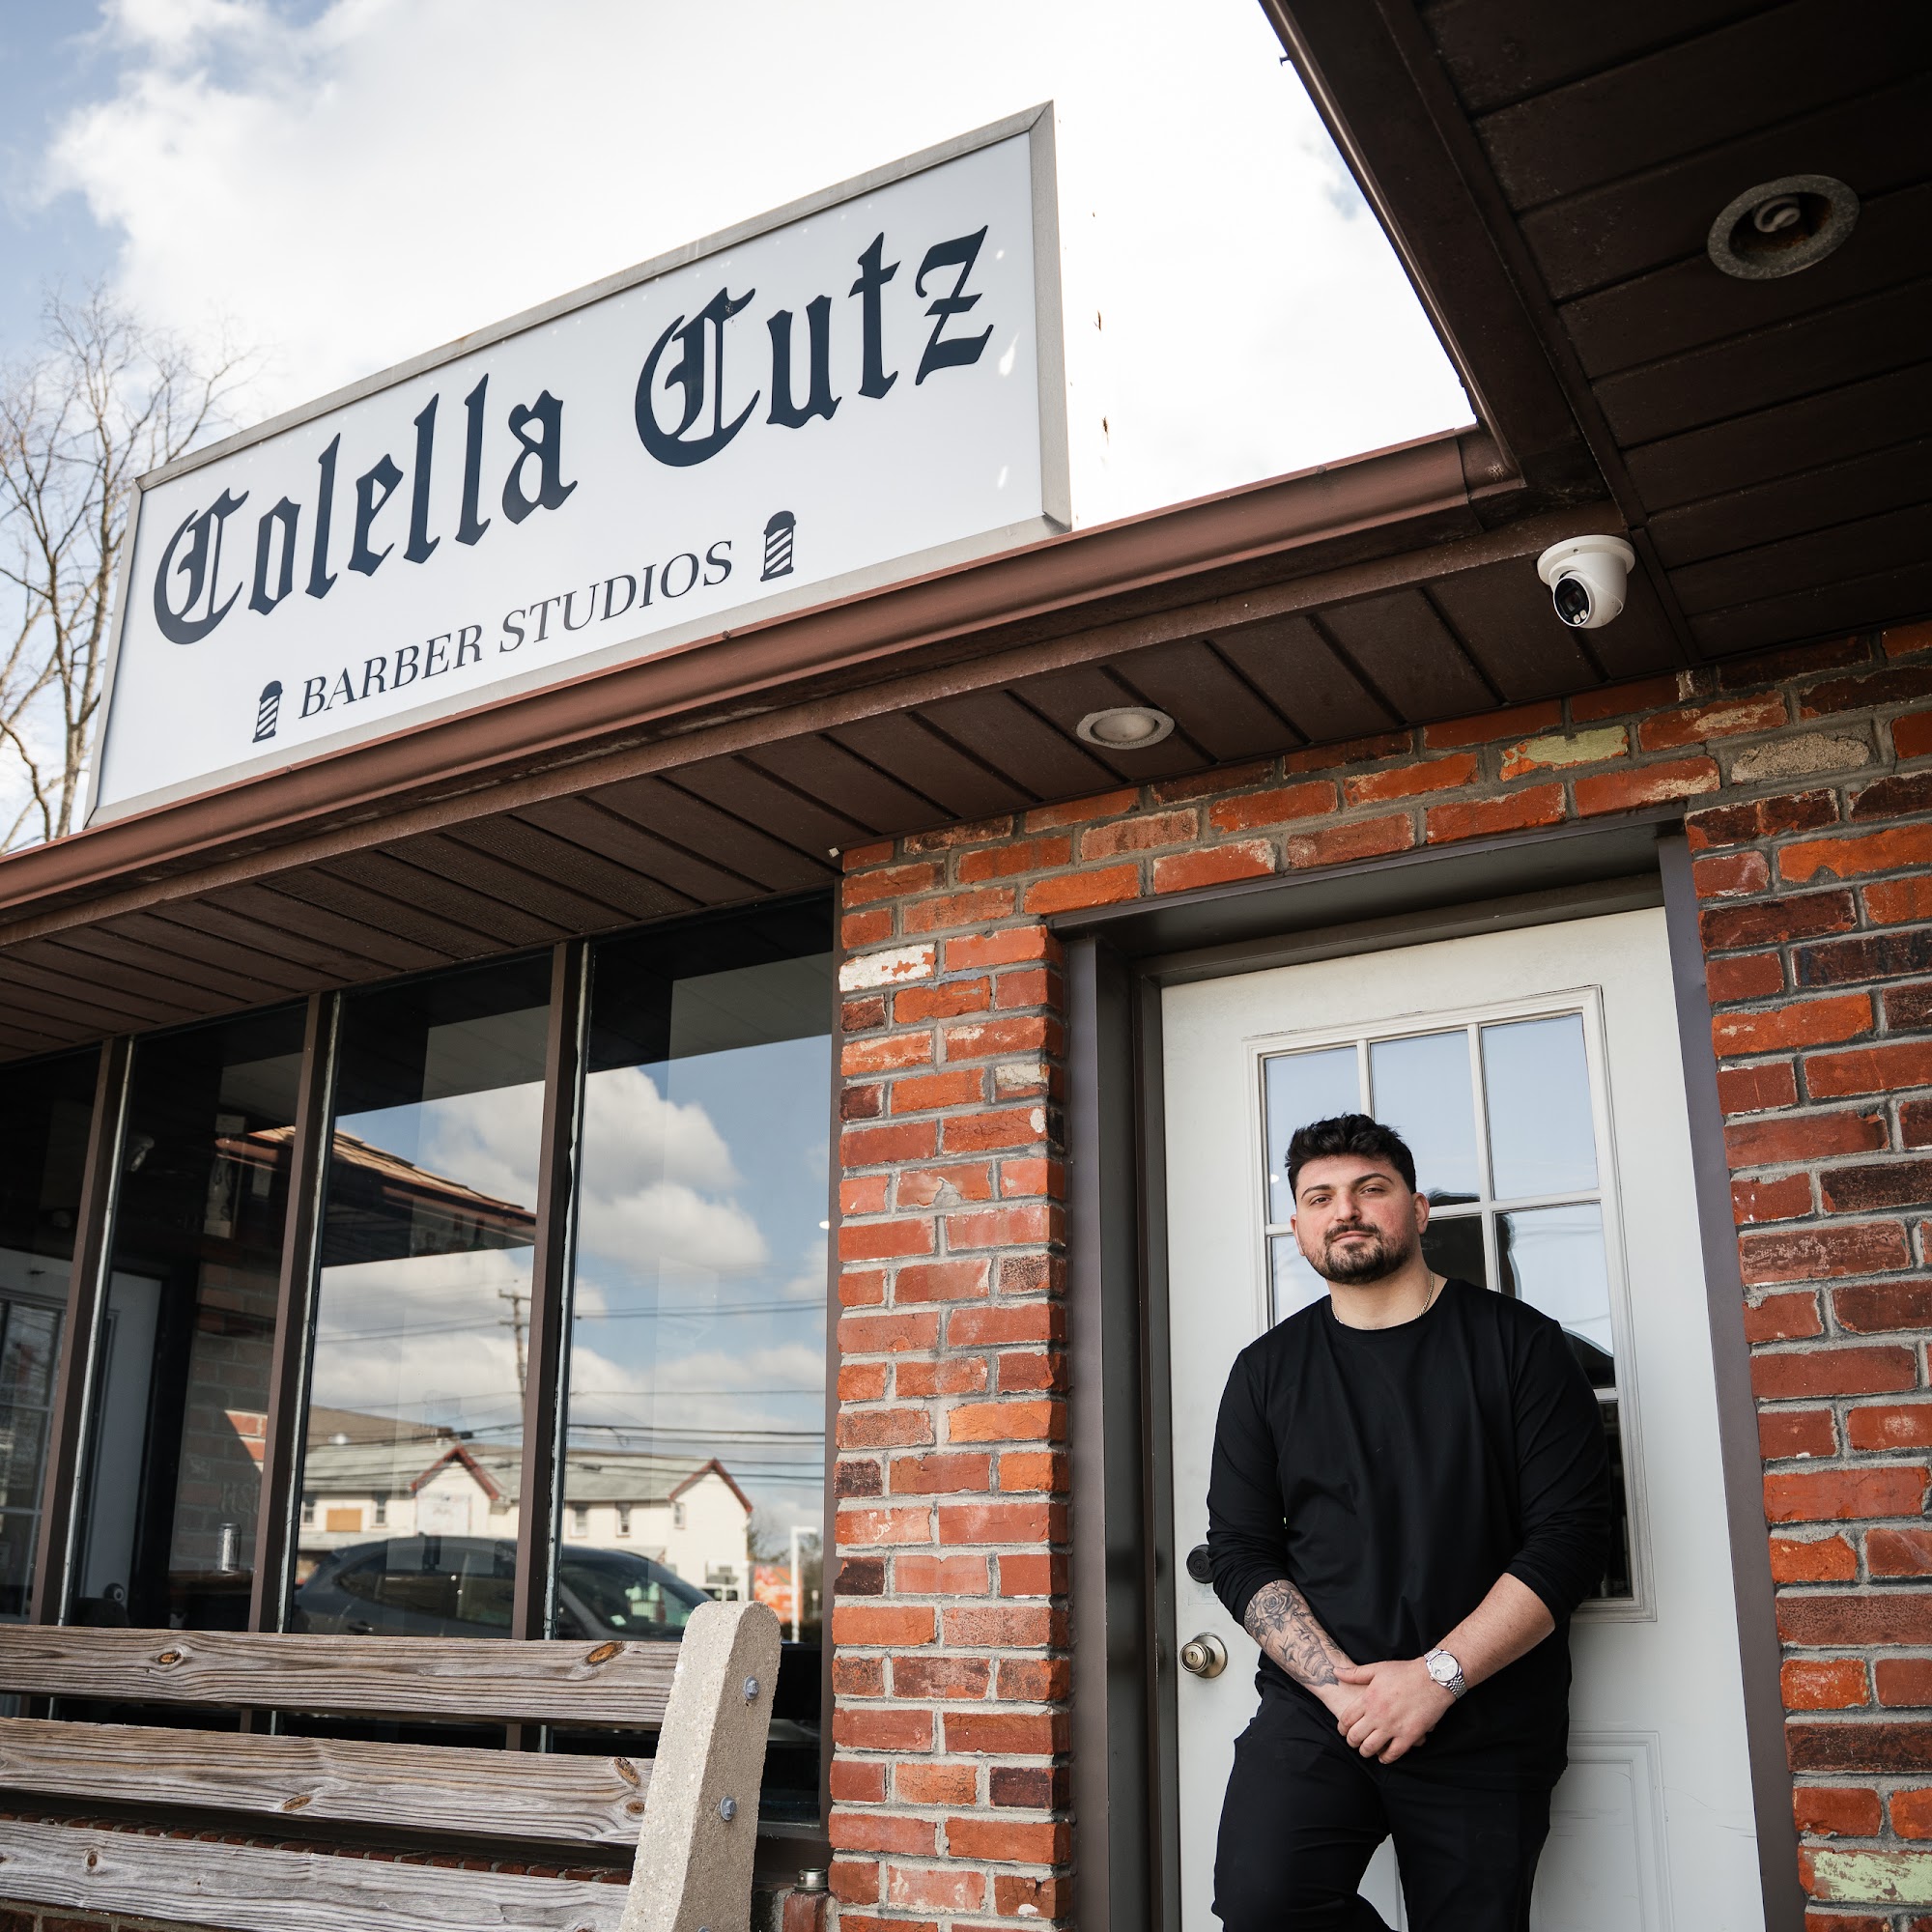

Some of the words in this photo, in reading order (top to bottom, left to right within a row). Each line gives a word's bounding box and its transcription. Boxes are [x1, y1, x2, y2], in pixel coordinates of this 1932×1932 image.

[154, 372, 579, 645] Colella
[634, 224, 995, 468] Cutz
[298, 624, 483, 720] BARBER
[497, 540, 733, 654] STUDIOS
